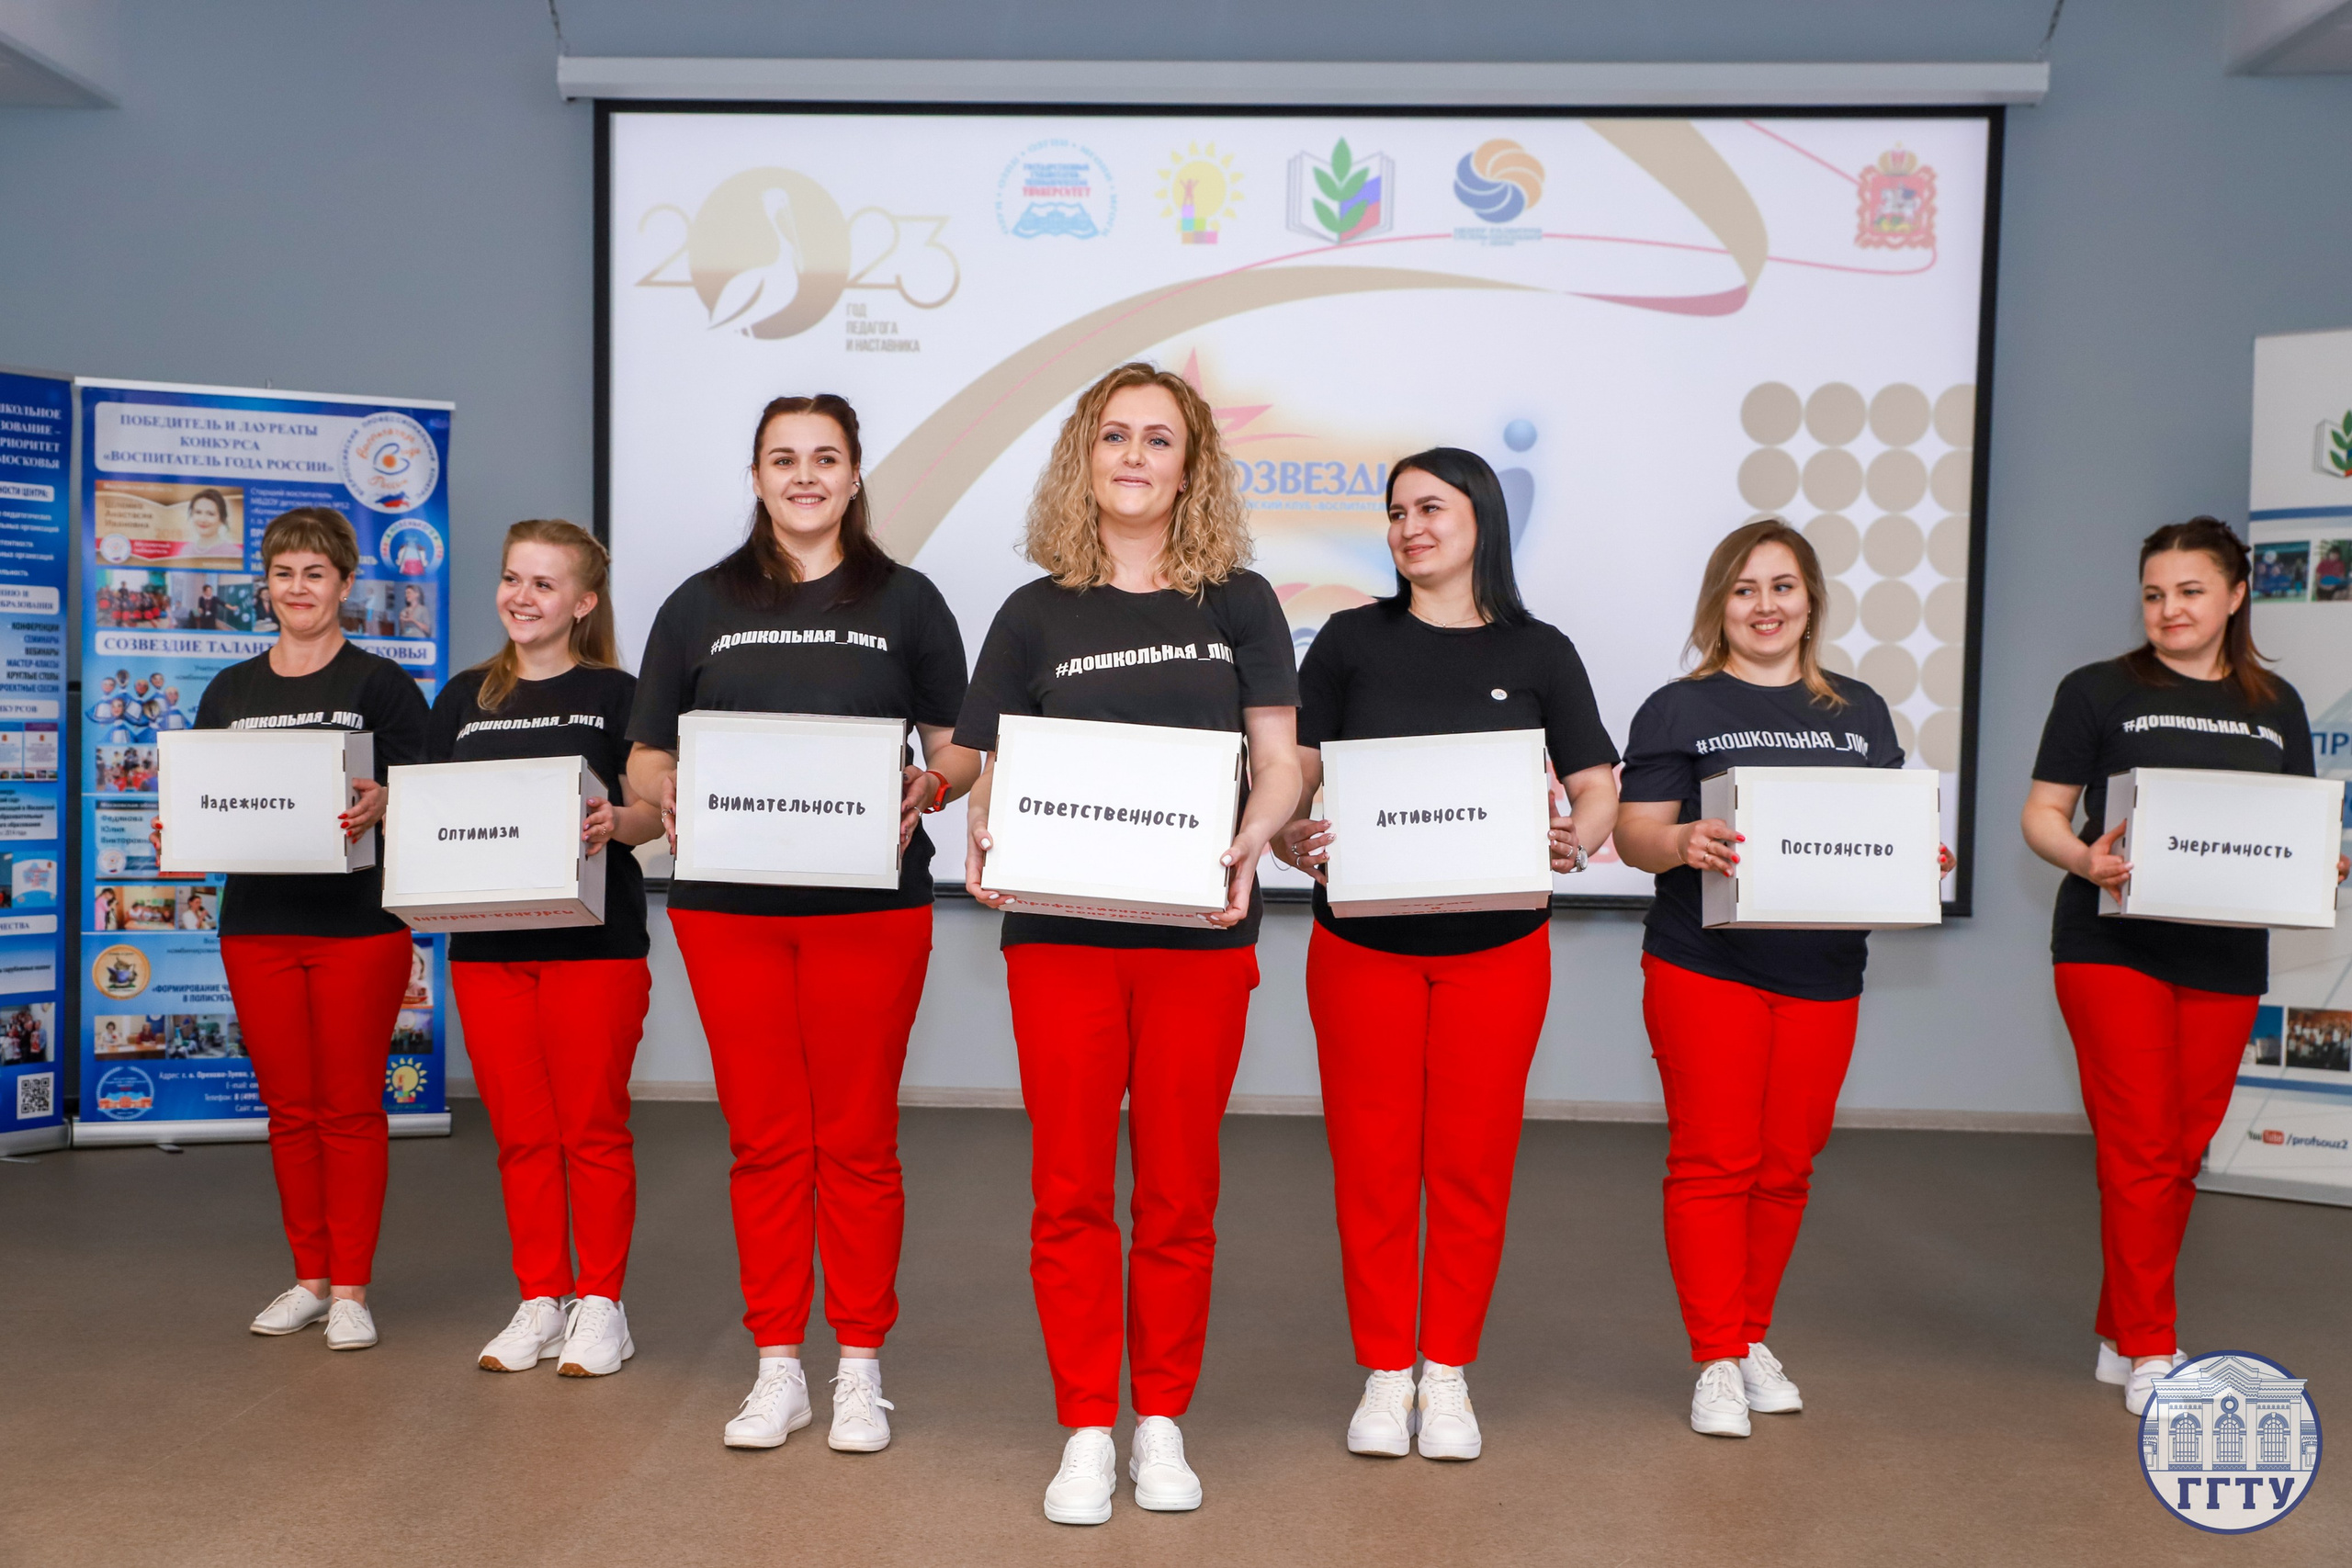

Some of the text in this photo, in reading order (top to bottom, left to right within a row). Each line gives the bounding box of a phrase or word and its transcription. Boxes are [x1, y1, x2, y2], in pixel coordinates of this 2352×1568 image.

[846, 303, 866, 318] ГОД
[846, 321, 899, 334] ПЕДАГОГА
[855, 339, 921, 353] НАСТАВНИКА
[120, 414, 318, 435] ПОБЕДИТЕЛЬ И ЛАУРЕАТЫ
[180, 436, 260, 451] КОНКУРСА
[103, 451, 334, 472] «ВОСПИТАТЕЛЬ ГОДА РОССИИ»
[104, 637, 205, 652] СОЗВЕЗДИЕ
[710, 629, 888, 655] #ДОШКОЛЬНАЯ_ЛИГА
[229, 711, 364, 729] ДОШКОЛЬНАЯ_ЛИГА
[457, 714, 605, 741] #ДОШКОЛЬНАЯ_ЛИГА
[200, 795, 296, 812] Надежность
[708, 794, 866, 816] Внимательность
[1019, 796, 1199, 829] Ответственность
[1376, 807, 1487, 828] Активность
[1781, 839, 1894, 857] Постоянство
[2167, 836, 2293, 859] Энергичность
[189, 994, 232, 1002] ПОЛИСУБЪ
